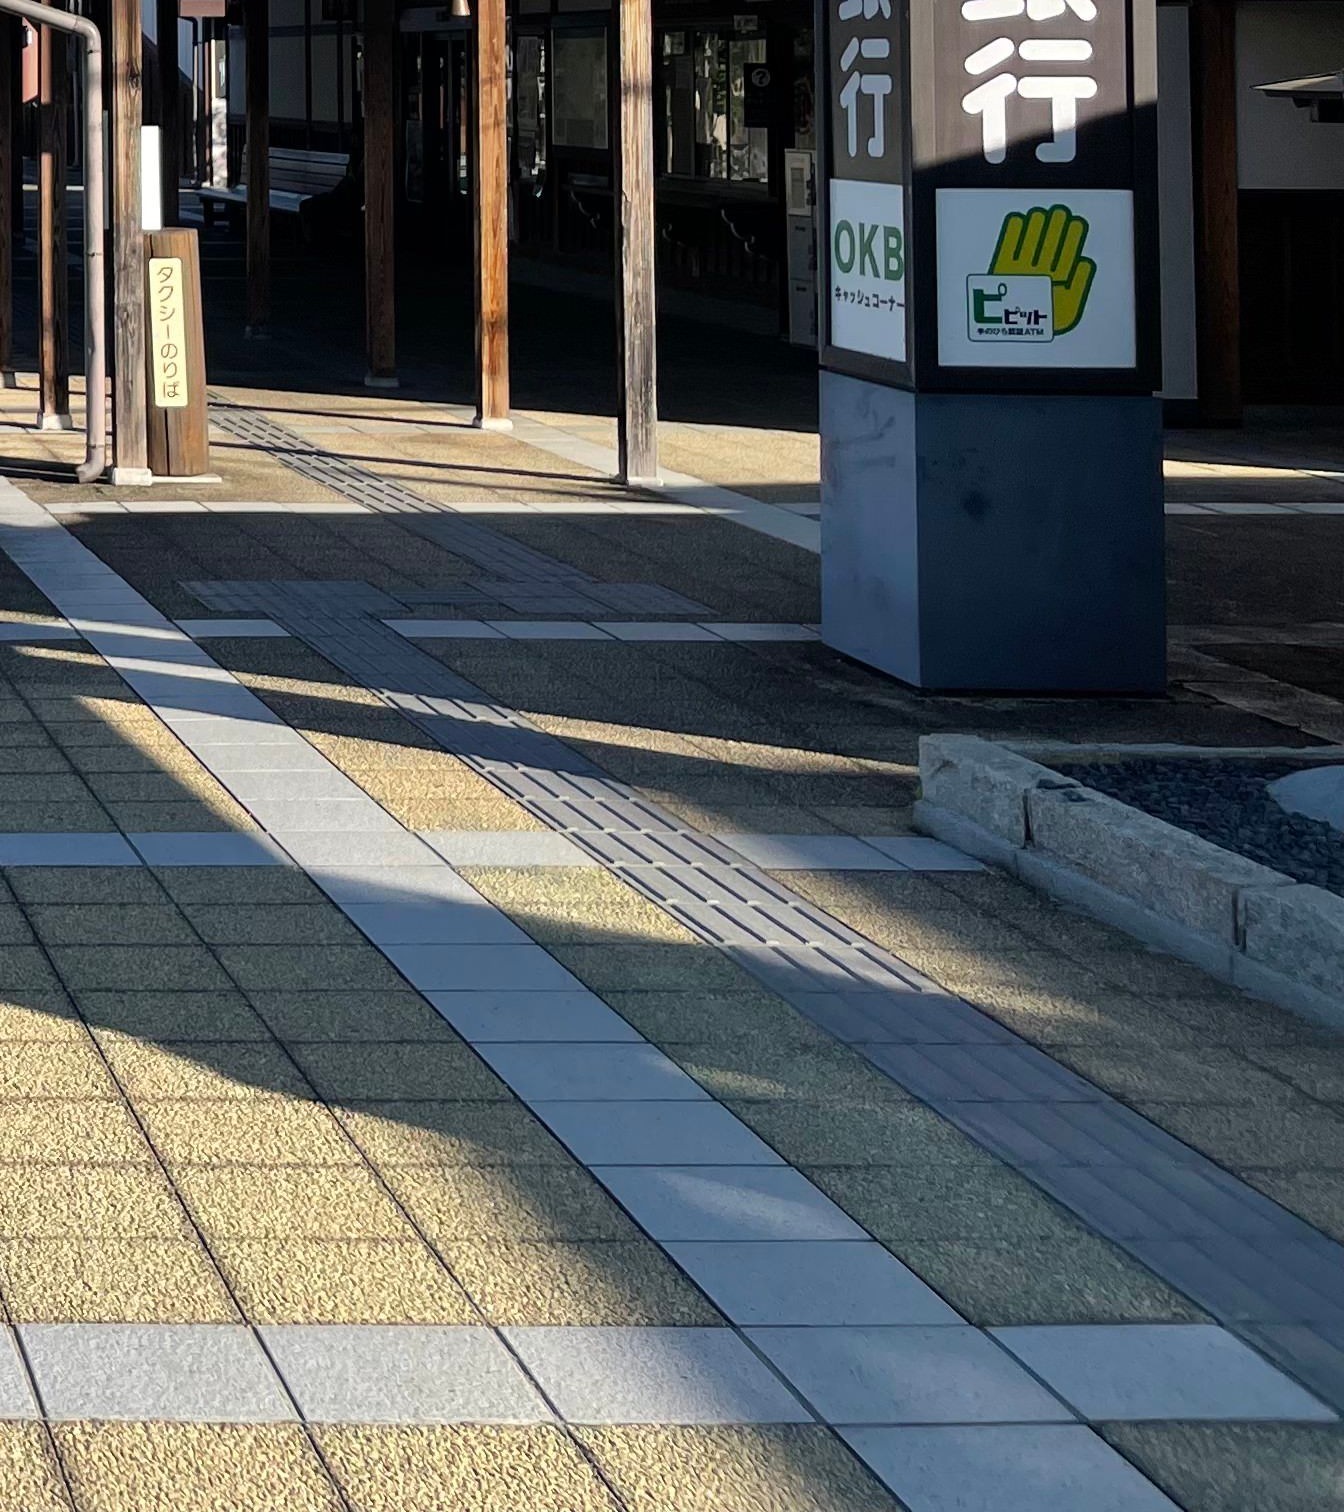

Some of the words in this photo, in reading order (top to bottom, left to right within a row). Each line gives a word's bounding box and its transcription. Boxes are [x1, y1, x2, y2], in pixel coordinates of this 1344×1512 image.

[835, 219, 904, 281] OKB
[835, 285, 904, 312] キャッシュコーナー
[156, 266, 180, 398] タクシーのりば
